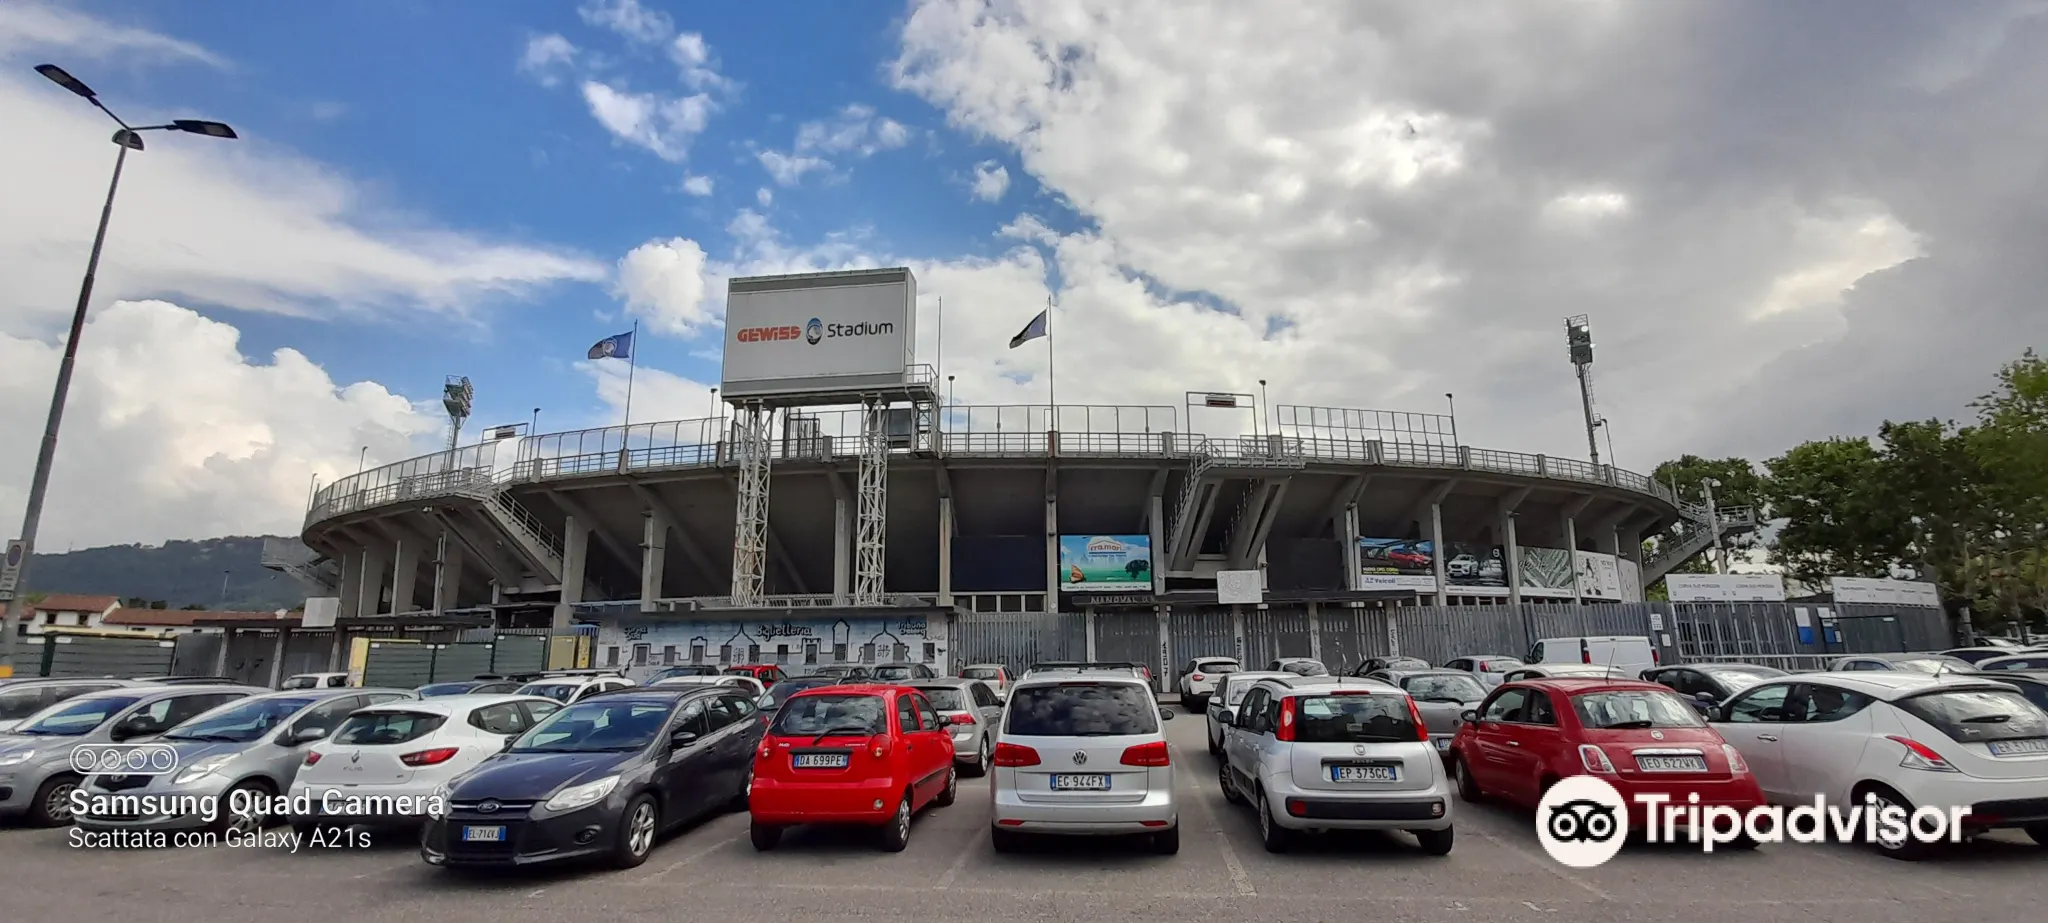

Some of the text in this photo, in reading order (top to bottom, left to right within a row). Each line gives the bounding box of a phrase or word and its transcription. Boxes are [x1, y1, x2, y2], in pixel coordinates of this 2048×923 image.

[827, 322, 893, 338] Stadium
[800, 756, 842, 765] DA 699PE
[1340, 768, 1388, 778] EP 373GC
[1057, 775, 1104, 787] EG 944FX
